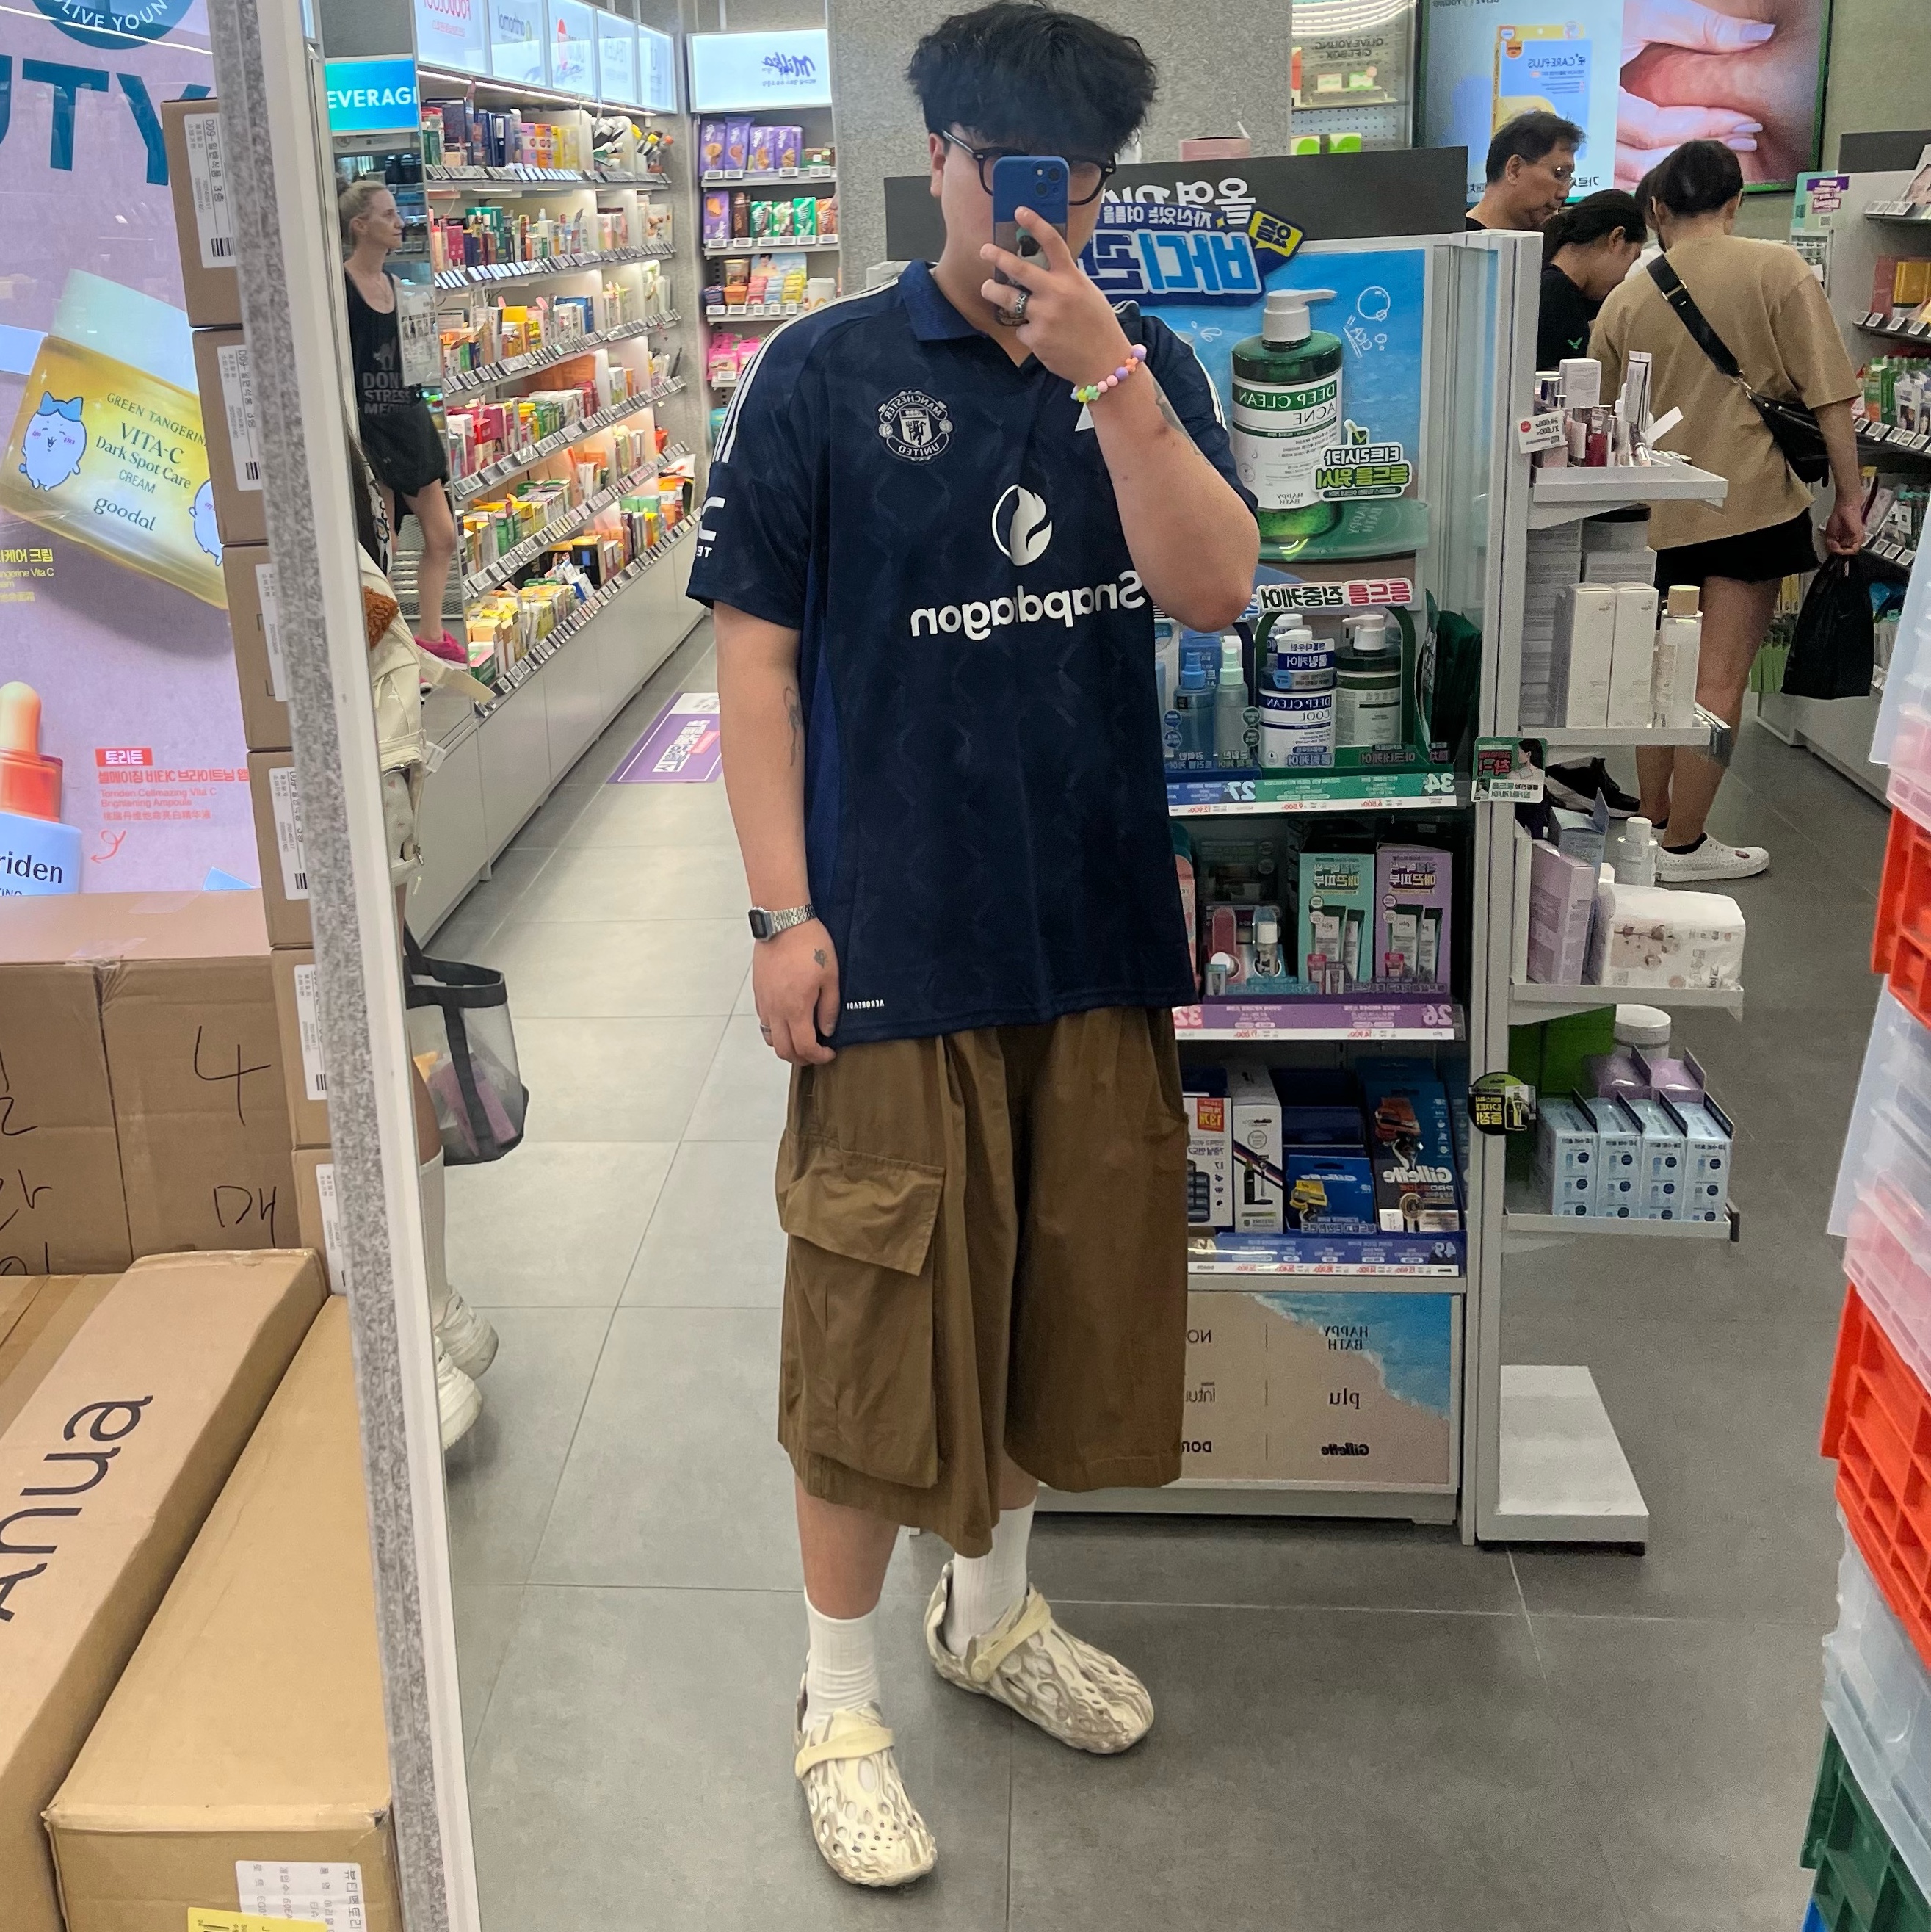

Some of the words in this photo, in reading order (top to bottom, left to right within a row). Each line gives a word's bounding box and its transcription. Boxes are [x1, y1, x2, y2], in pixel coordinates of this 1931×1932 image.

[55, 0, 105, 29] LIVE
[112, 0, 170, 31] YOUN
[327, 86, 416, 109] EVERAG
[0, 54, 212, 187] TY
[363, 372, 400, 389] DON
[364, 389, 410, 403] STRESS
[106, 392, 145, 417] GREEN
[148, 410, 208, 446] TANGERIN
[120, 422, 185, 466] VITA-C
[95, 435, 127, 461] Dark
[128, 451, 161, 479] Spot
[162, 466, 192, 490] Care
[118, 468, 156, 495] CREAM
[93, 496, 157, 532] goodal
[29, 548, 54, 562] 크림
[46, 567, 55, 576] C
[104, 749, 145, 765] 토리든
[145, 769, 176, 784] 비타C
[177, 768, 236, 784] 브라이트닝
[100, 798, 151, 809] Brightening
[153, 798, 193, 808] Ampoule
[209, 787, 217, 797] C
[194, 1025, 271, 1126] 4
